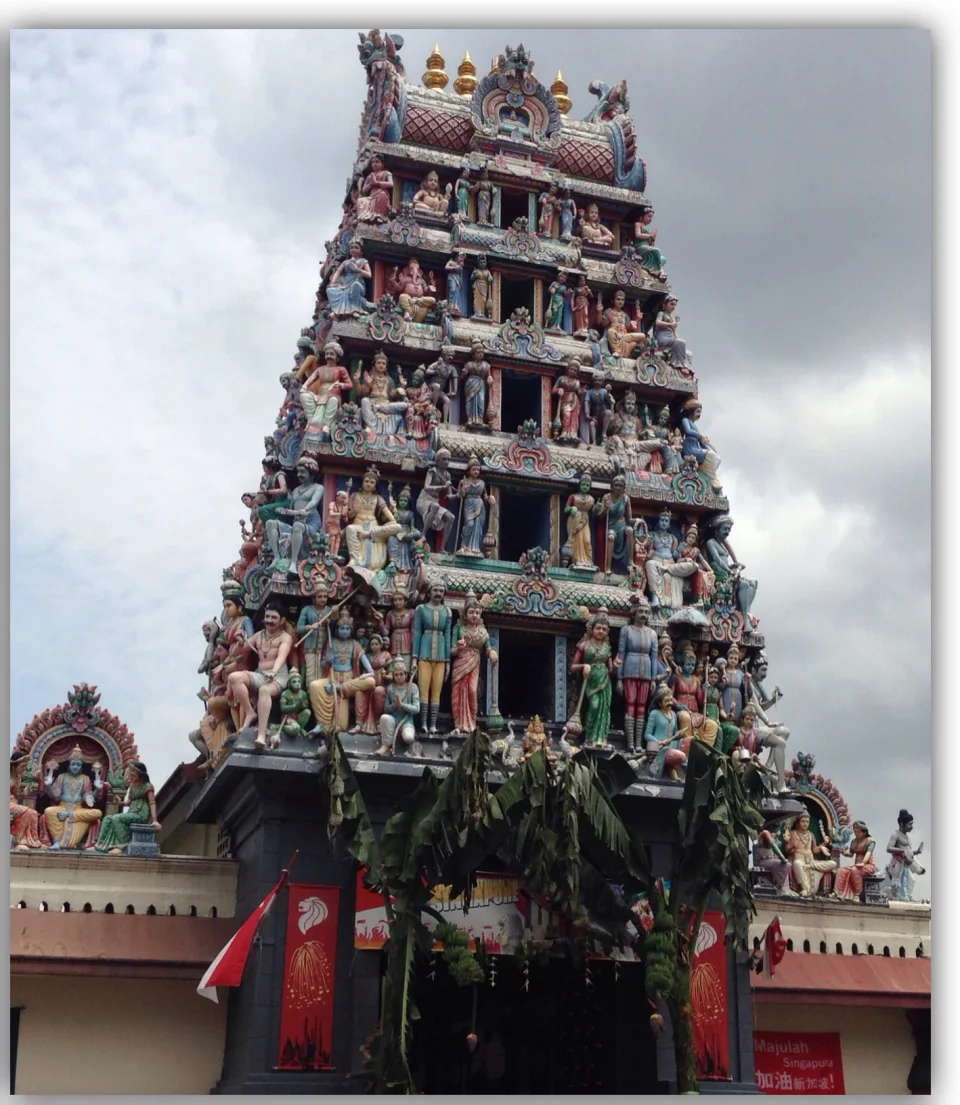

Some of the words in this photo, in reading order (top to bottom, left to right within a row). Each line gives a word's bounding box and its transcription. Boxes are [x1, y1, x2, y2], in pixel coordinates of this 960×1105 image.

[429, 878, 519, 912] SINAPORE
[754, 1039, 809, 1056] Majulah
[783, 1057, 834, 1071] Singapura
